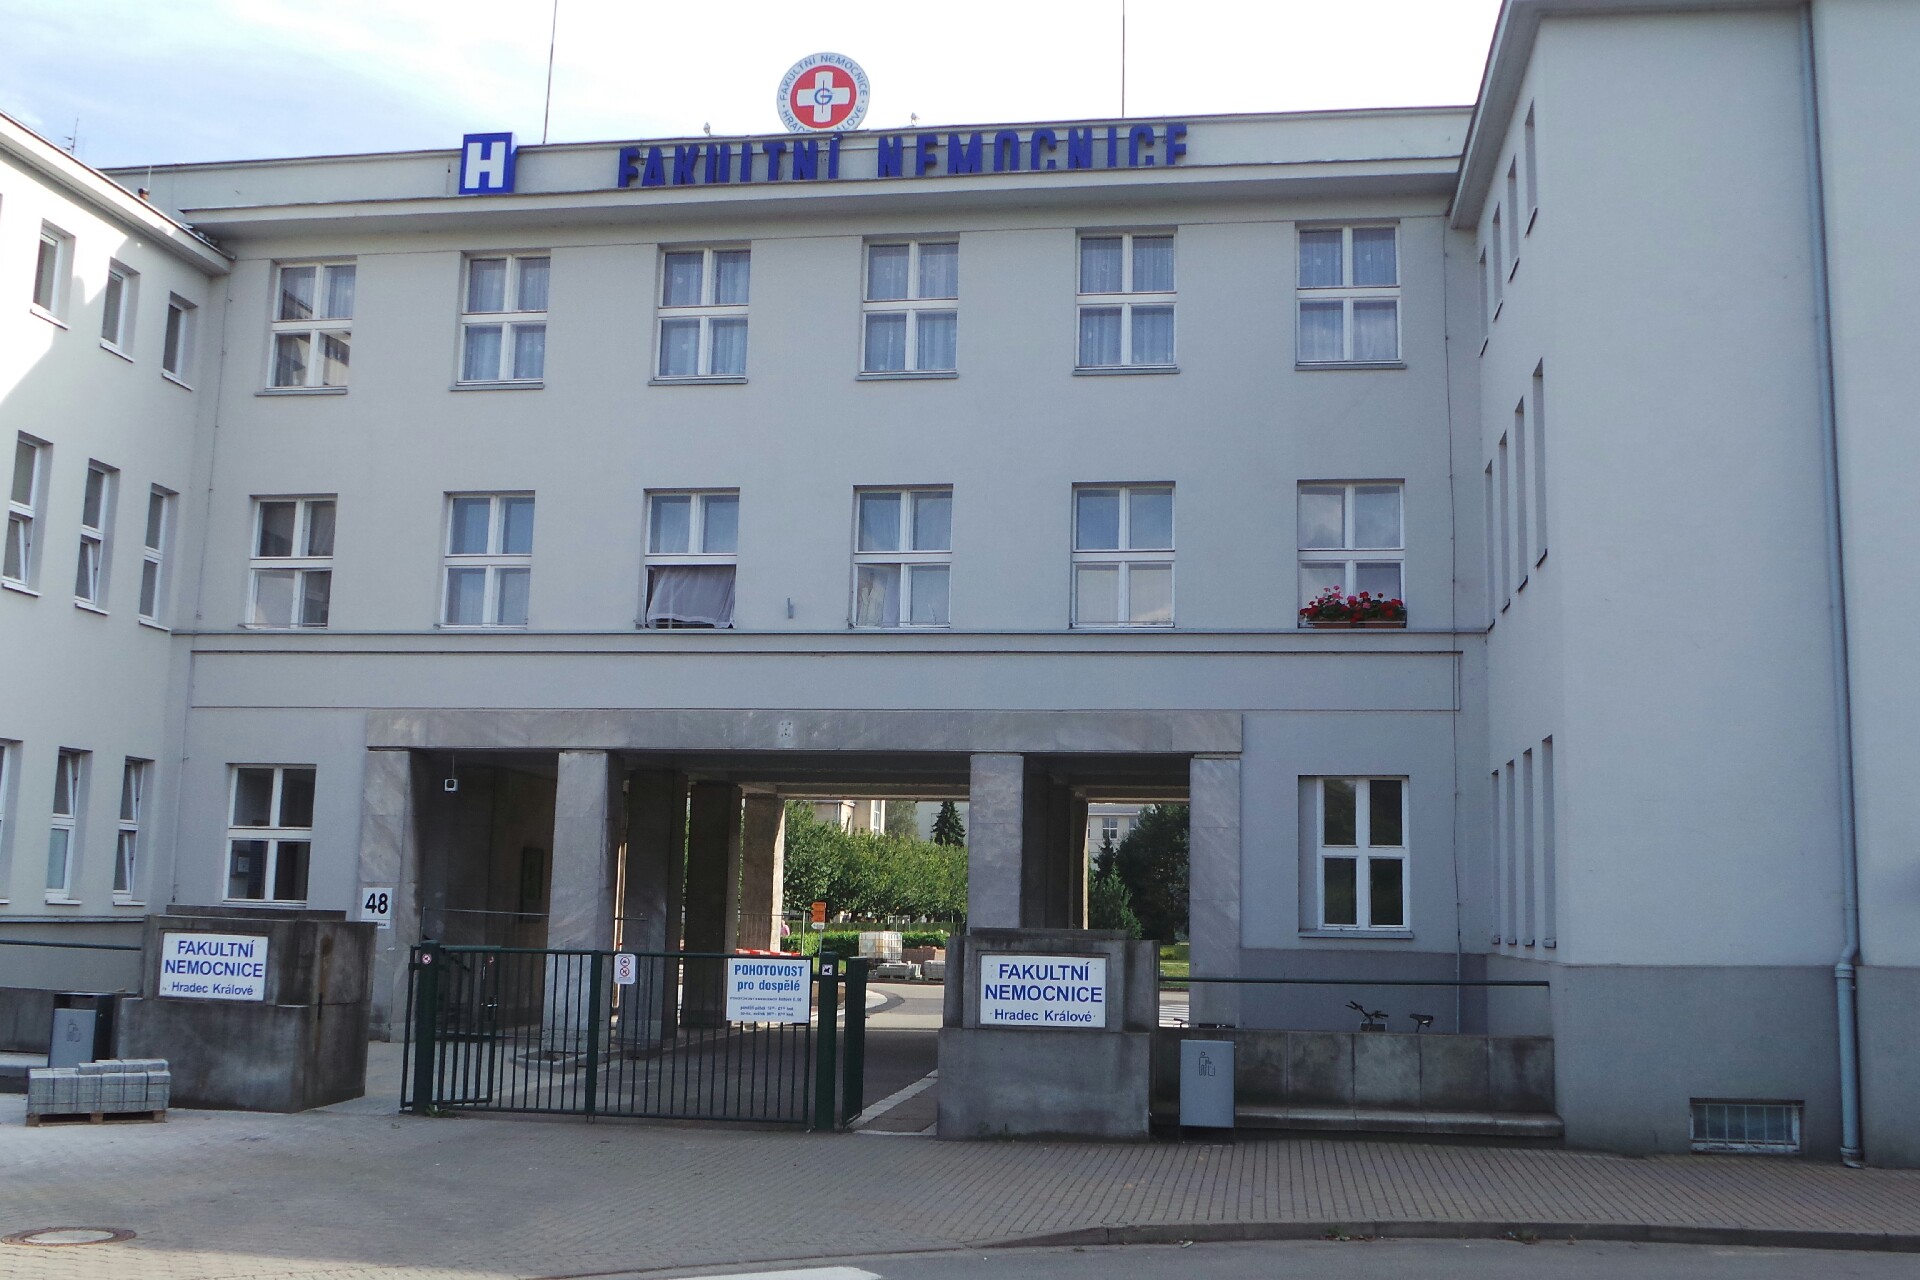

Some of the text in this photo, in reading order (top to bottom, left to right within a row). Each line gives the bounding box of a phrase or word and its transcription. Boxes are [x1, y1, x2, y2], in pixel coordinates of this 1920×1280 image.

[464, 141, 506, 189] H
[365, 892, 388, 915] 48
[177, 939, 255, 958] FAKULTNÍ
[164, 959, 264, 978] NEMOCNICE
[734, 964, 805, 977] POHOTOVOST
[998, 961, 1091, 981] FAKULTNÍ
[171, 981, 254, 996] Hradec Králové
[737, 979, 801, 993] pro dospělé
[985, 984, 1103, 1003] NEMOCNICE
[994, 1008, 1092, 1023] Hradec Králové
